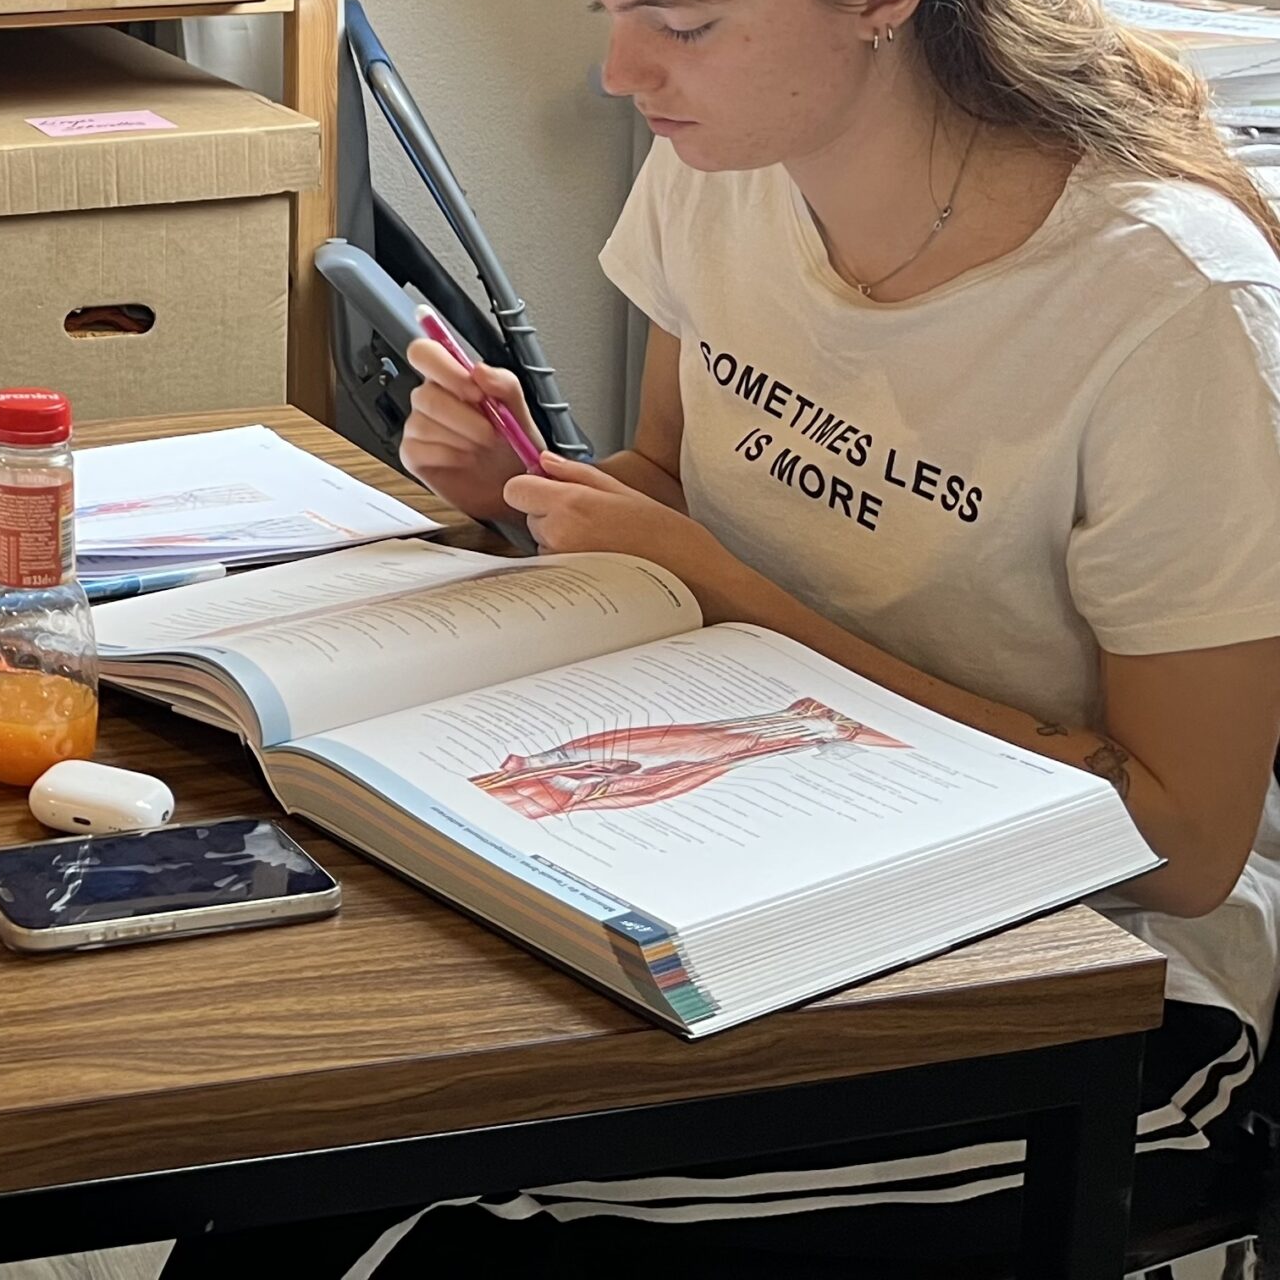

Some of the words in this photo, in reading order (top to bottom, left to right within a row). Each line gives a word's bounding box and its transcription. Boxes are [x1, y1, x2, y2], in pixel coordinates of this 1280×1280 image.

[700, 340, 873, 467] SOMETIMES
[883, 448, 983, 523] LESS
[735, 427, 773, 462] IS
[769, 447, 883, 532] MORE
